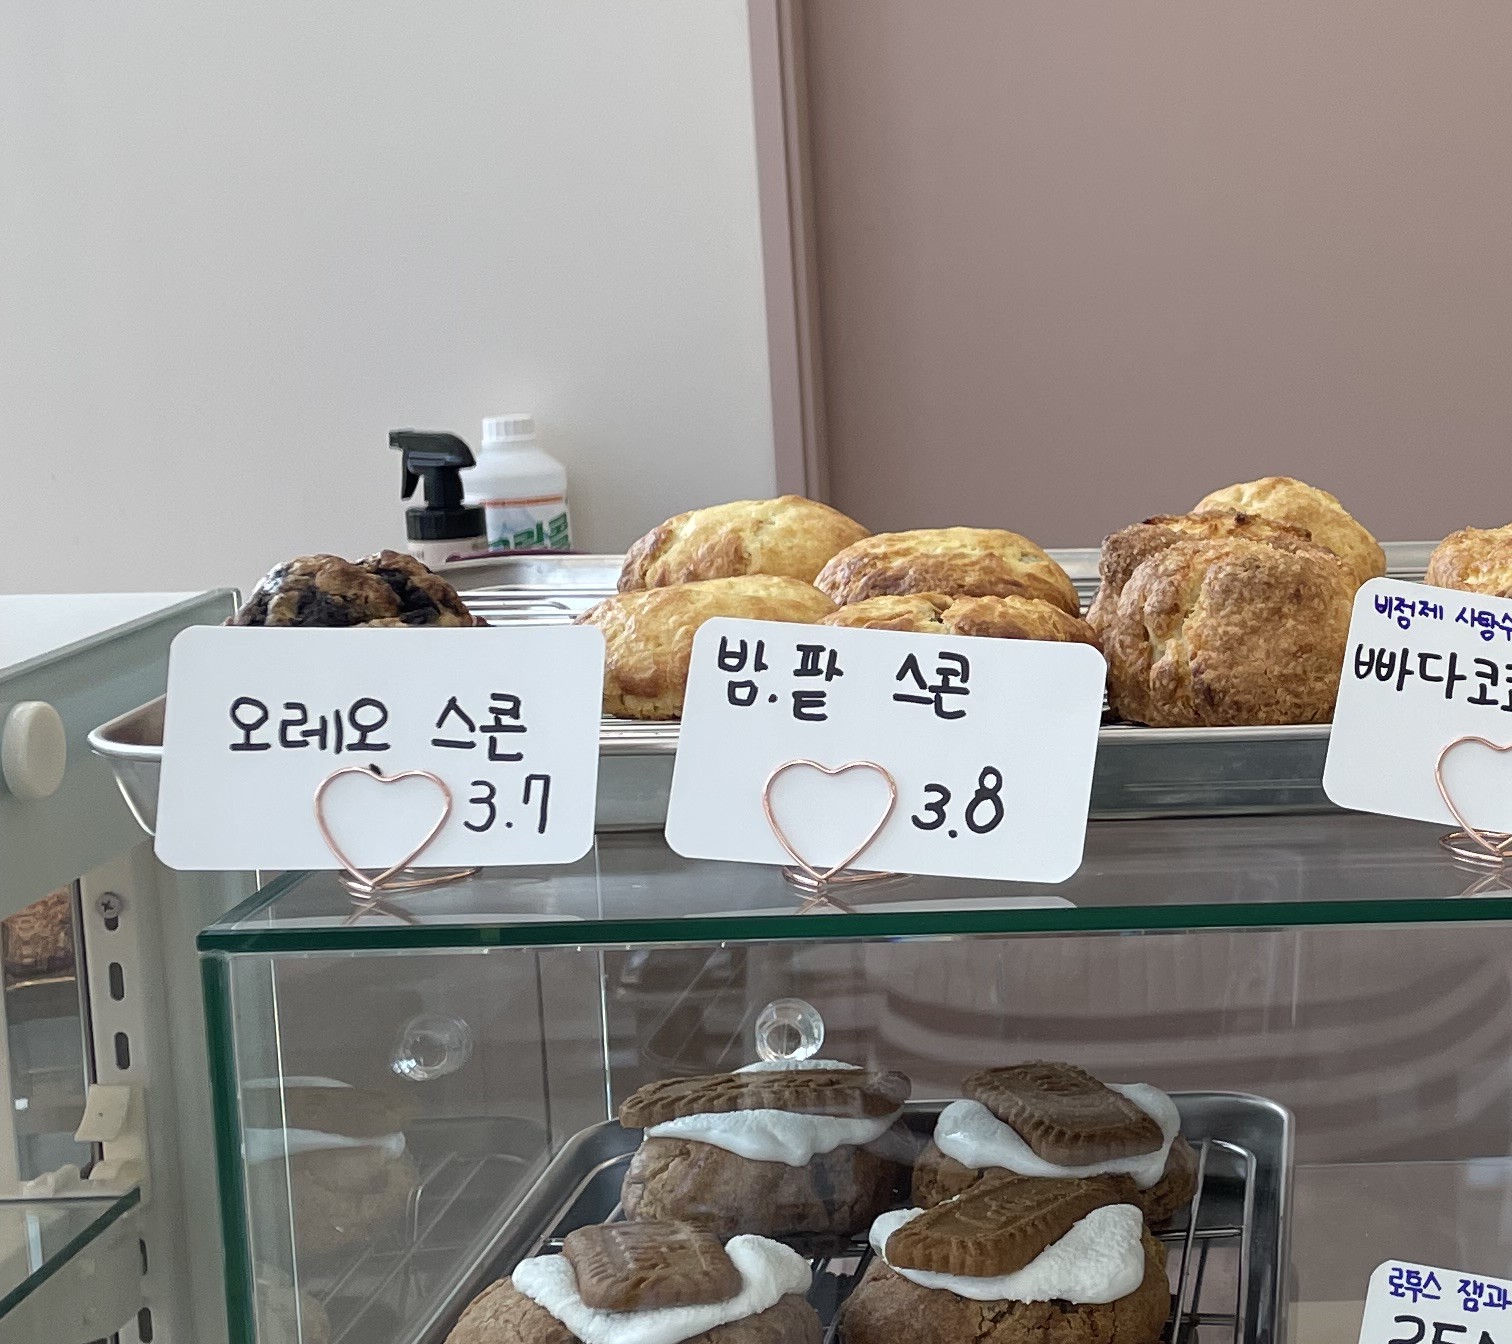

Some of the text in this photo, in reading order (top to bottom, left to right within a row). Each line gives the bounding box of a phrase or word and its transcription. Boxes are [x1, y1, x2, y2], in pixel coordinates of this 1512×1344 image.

[1375, 595, 1443, 630] 비정제
[718, 636, 970, 721] 밤.팥 스콘
[229, 693, 527, 761] 오레오 스콘
[463, 774, 550, 834] 3.7
[911, 766, 1004, 838] 3.8
[1389, 1267, 1442, 1303] 로투스
[1457, 1279, 1512, 1312] 잼과
